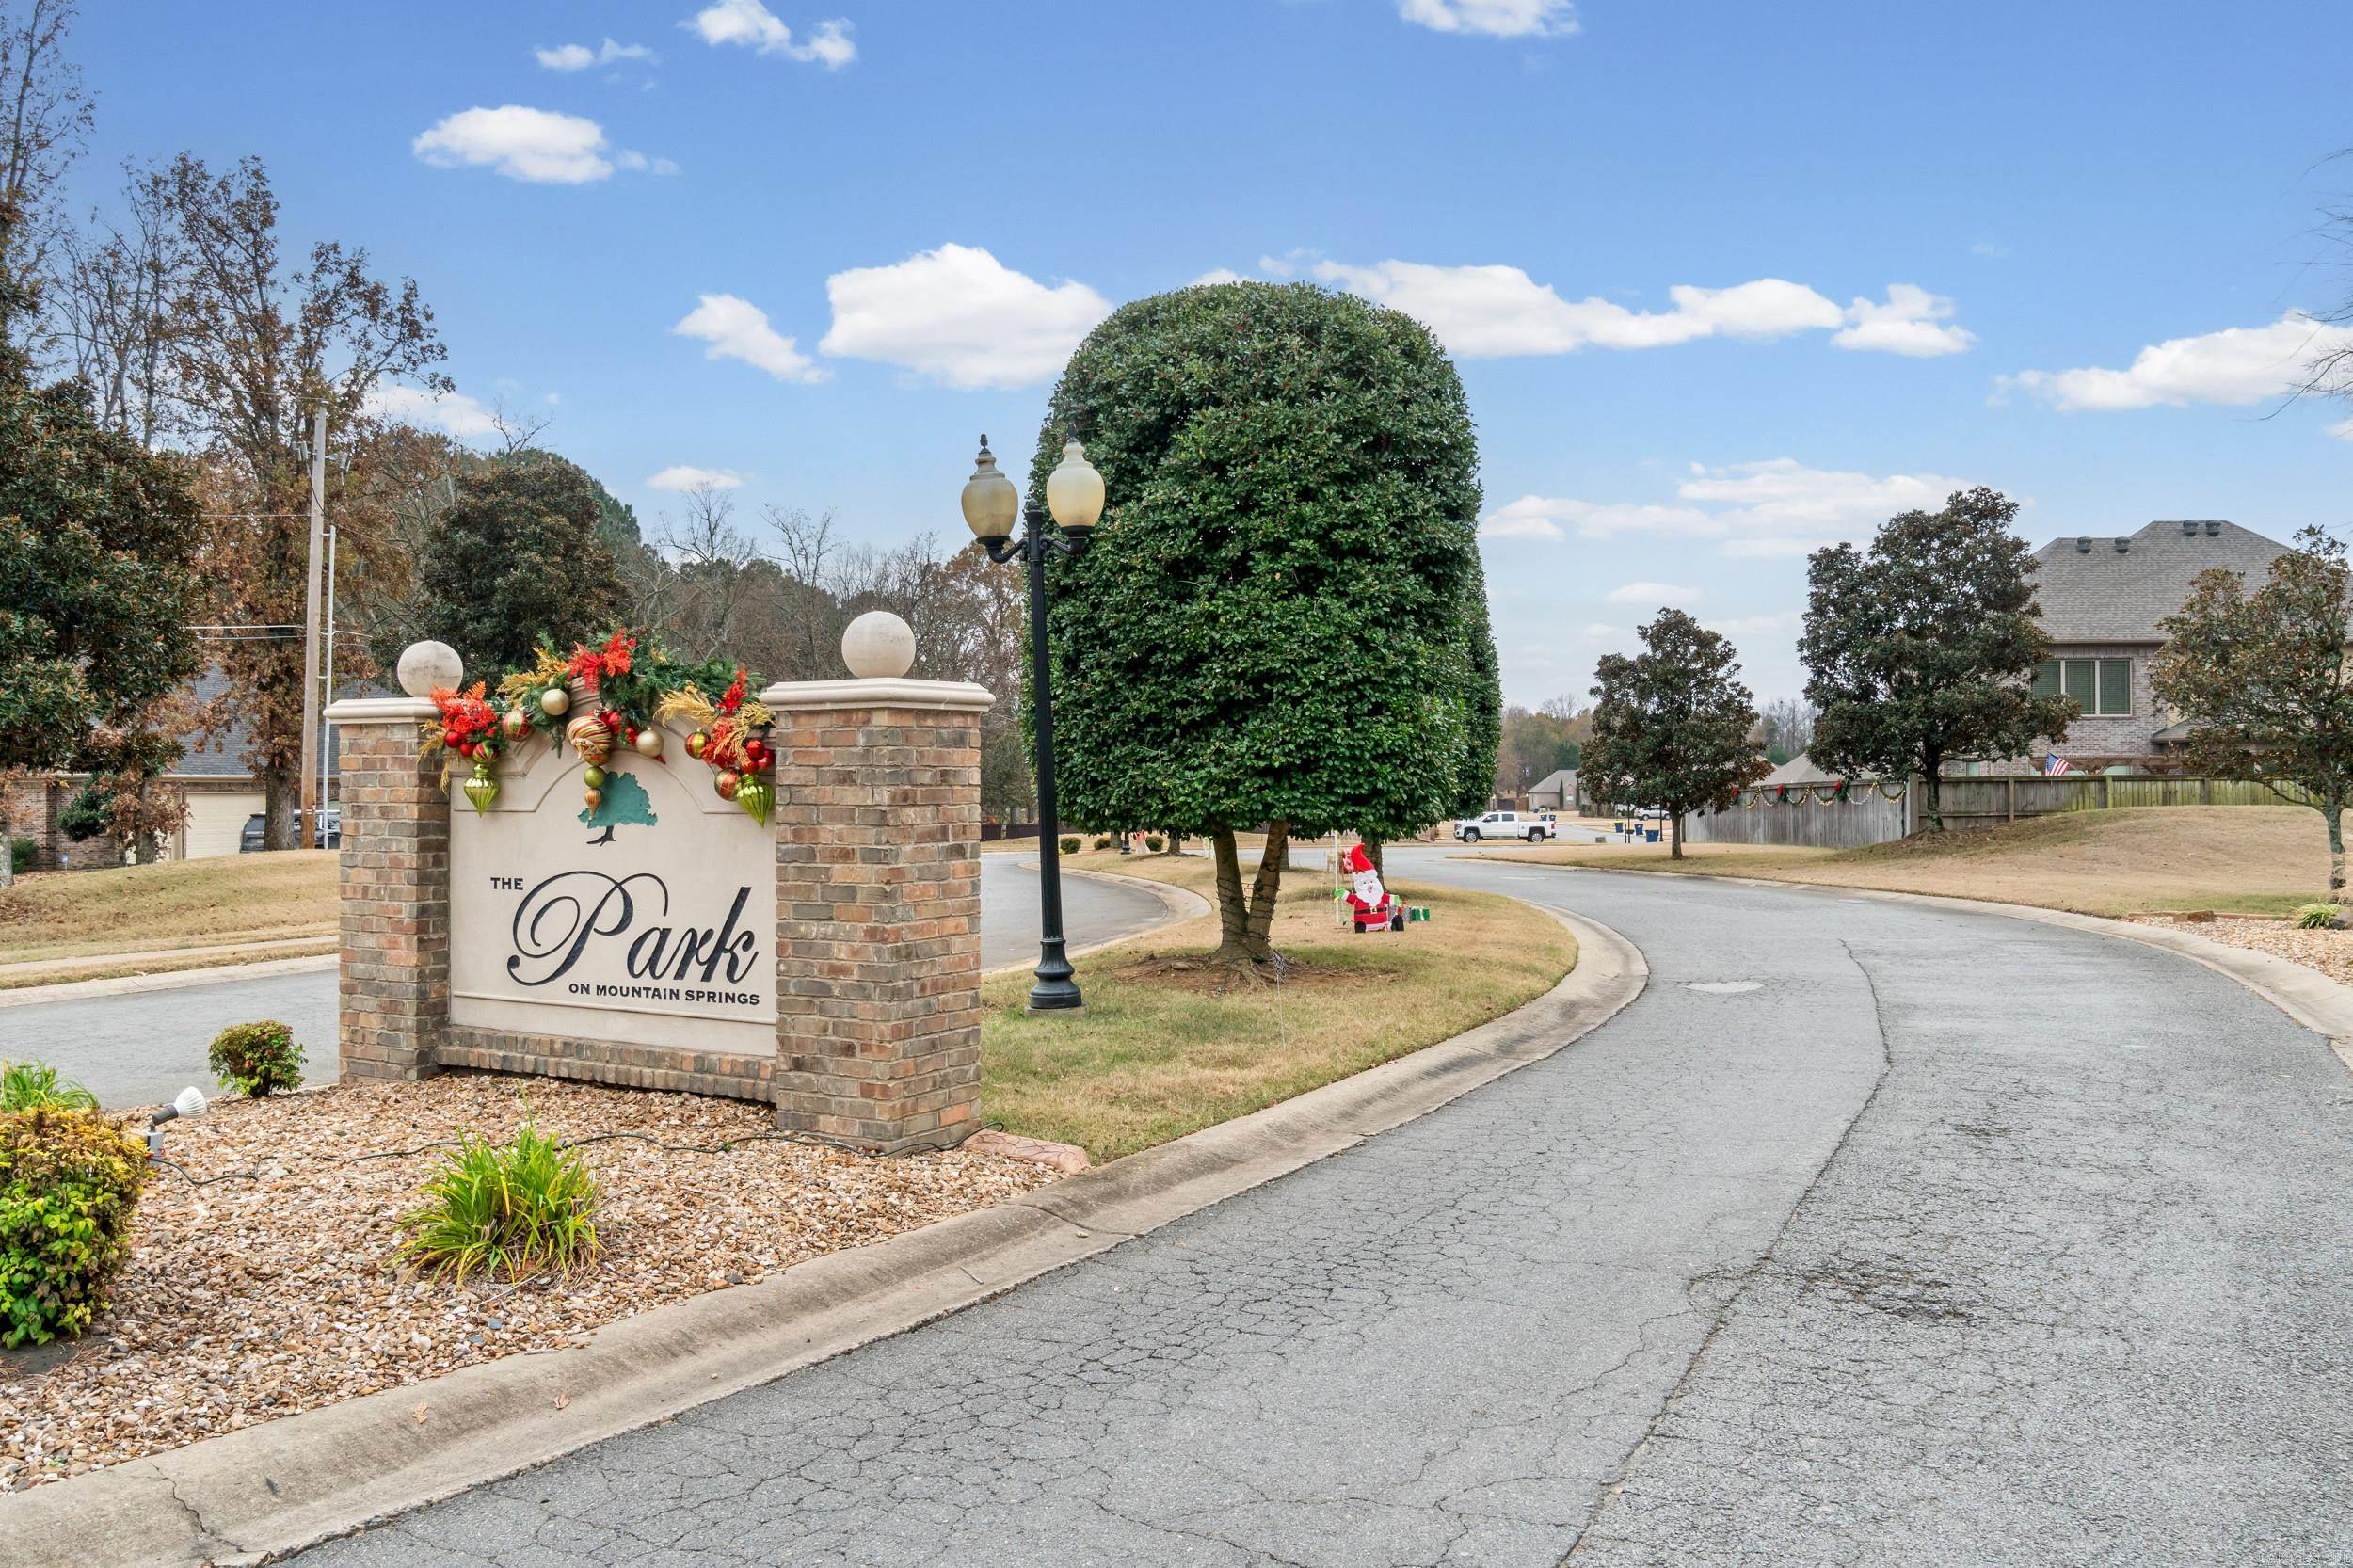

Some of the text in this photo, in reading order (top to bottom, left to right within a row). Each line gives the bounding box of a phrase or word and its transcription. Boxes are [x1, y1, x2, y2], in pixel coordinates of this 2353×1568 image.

[490, 877, 524, 890] THE
[507, 871, 759, 986] Park
[568, 984, 760, 1005] ON MOUNTAIN SPRINGS
